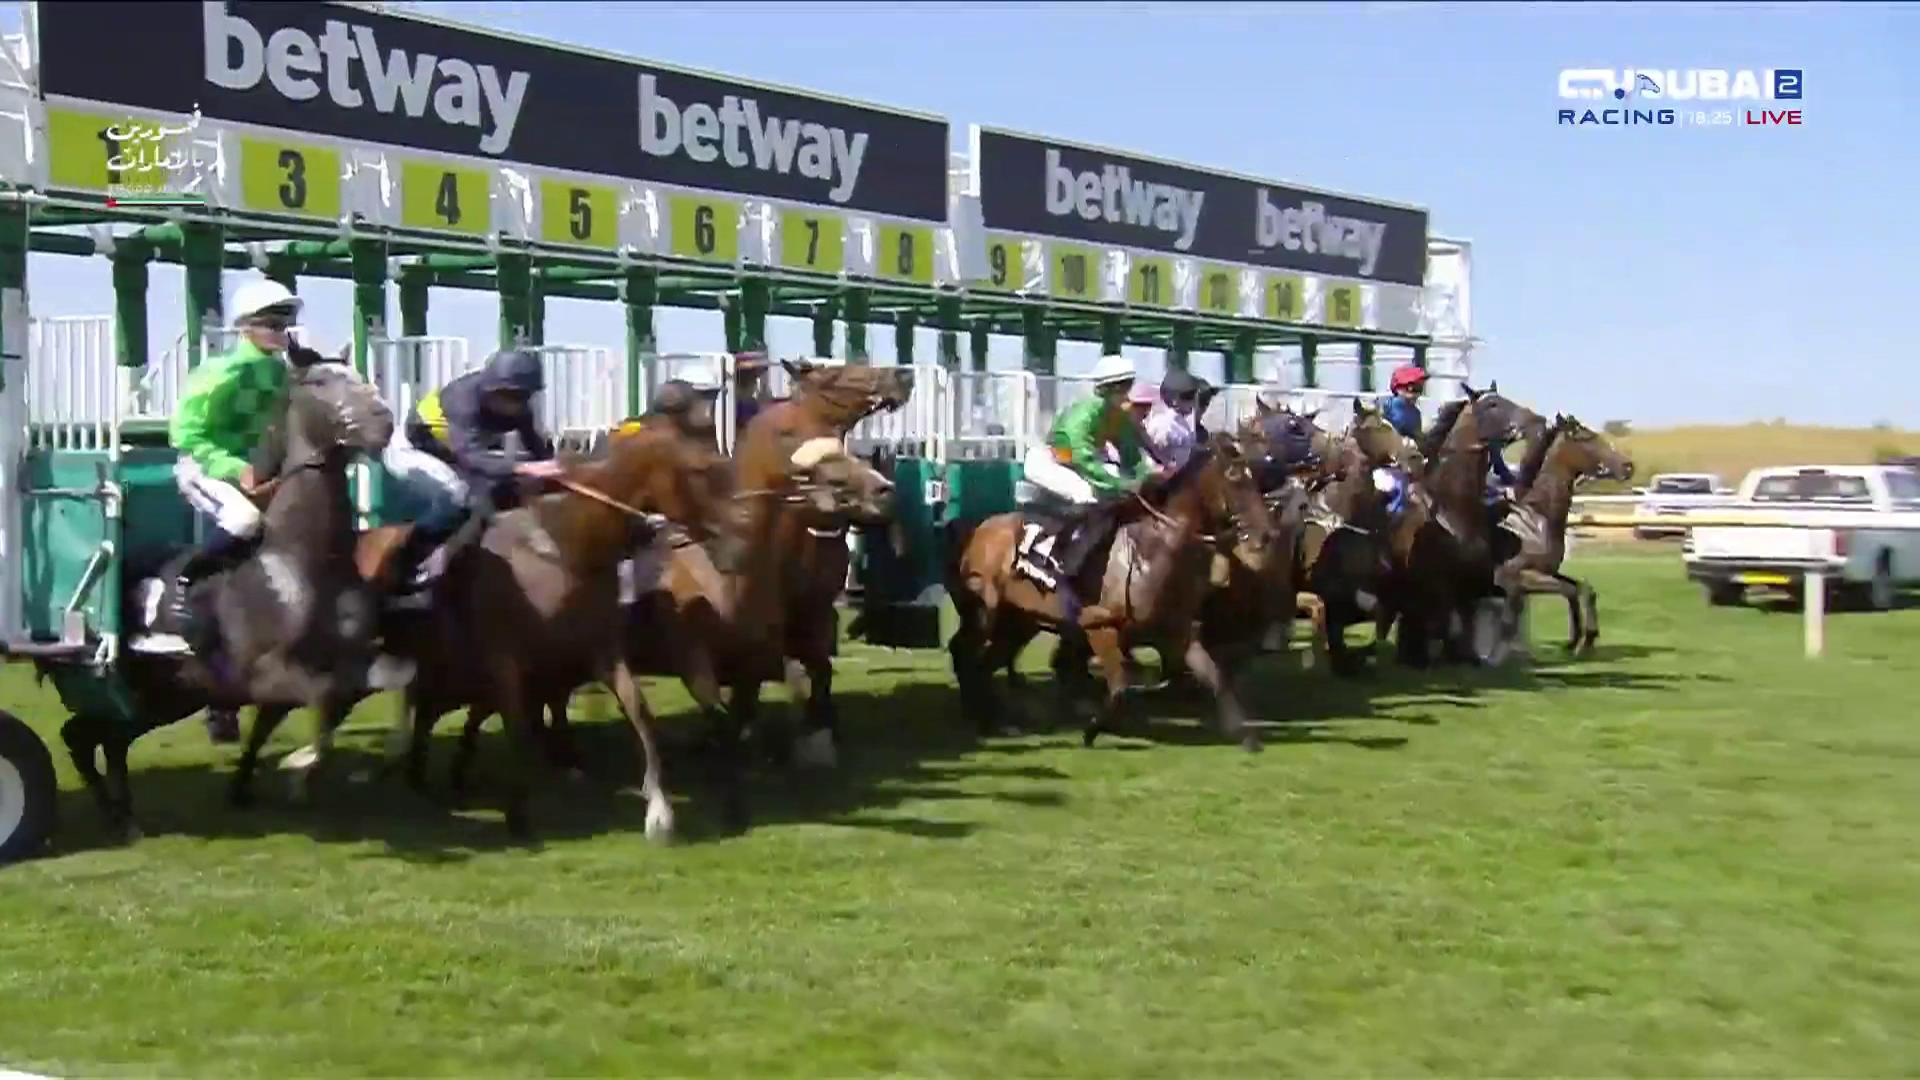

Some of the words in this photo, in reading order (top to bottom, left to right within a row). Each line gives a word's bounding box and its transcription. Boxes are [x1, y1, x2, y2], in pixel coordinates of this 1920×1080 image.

[203, 1, 531, 154] betway
[637, 73, 869, 202] betway
[277, 149, 307, 209] 3
[435, 172, 461, 224] 4
[1044, 148, 1206, 250] betway
[569, 188, 592, 240] 5
[694, 205, 716, 254] 6
[1256, 187, 1386, 276] betway
[804, 219, 820, 265] 7
[990, 244, 1006, 286] 9
[1140, 264, 1160, 303] 11
